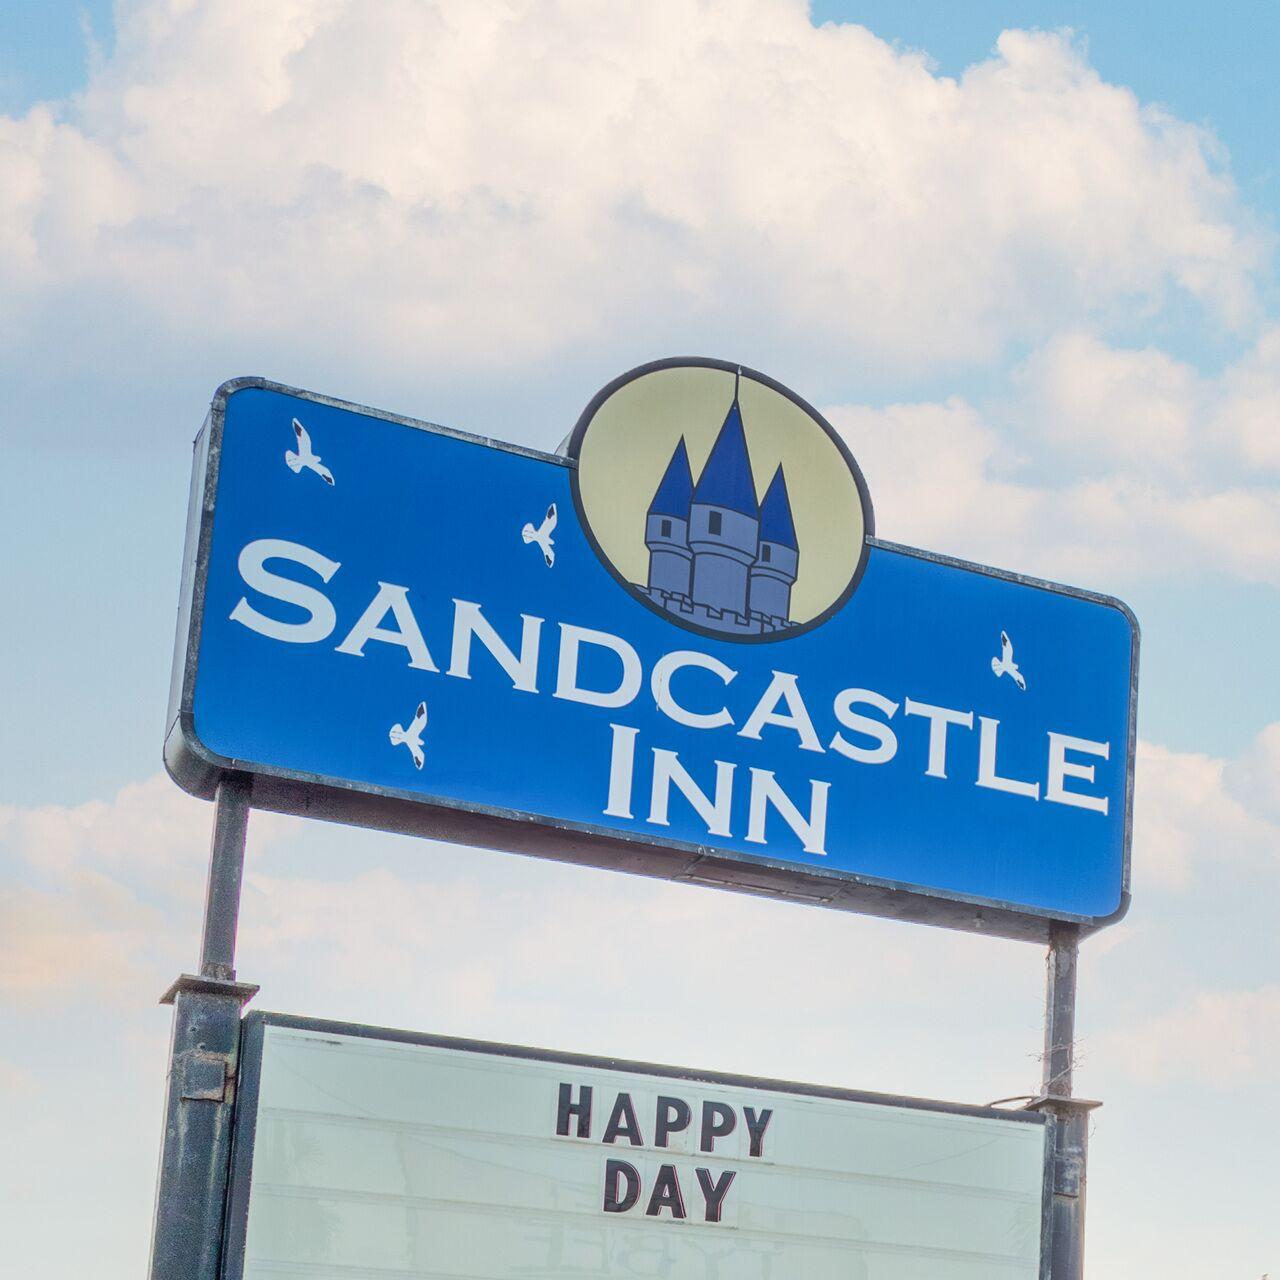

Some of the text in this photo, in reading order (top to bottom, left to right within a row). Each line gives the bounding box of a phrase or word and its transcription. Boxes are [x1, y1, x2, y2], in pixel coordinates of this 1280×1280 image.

[228, 537, 1111, 816] SANDCASTLE
[602, 723, 831, 857] INN
[556, 1082, 774, 1158] HAPPY
[603, 1158, 737, 1223] DAY
